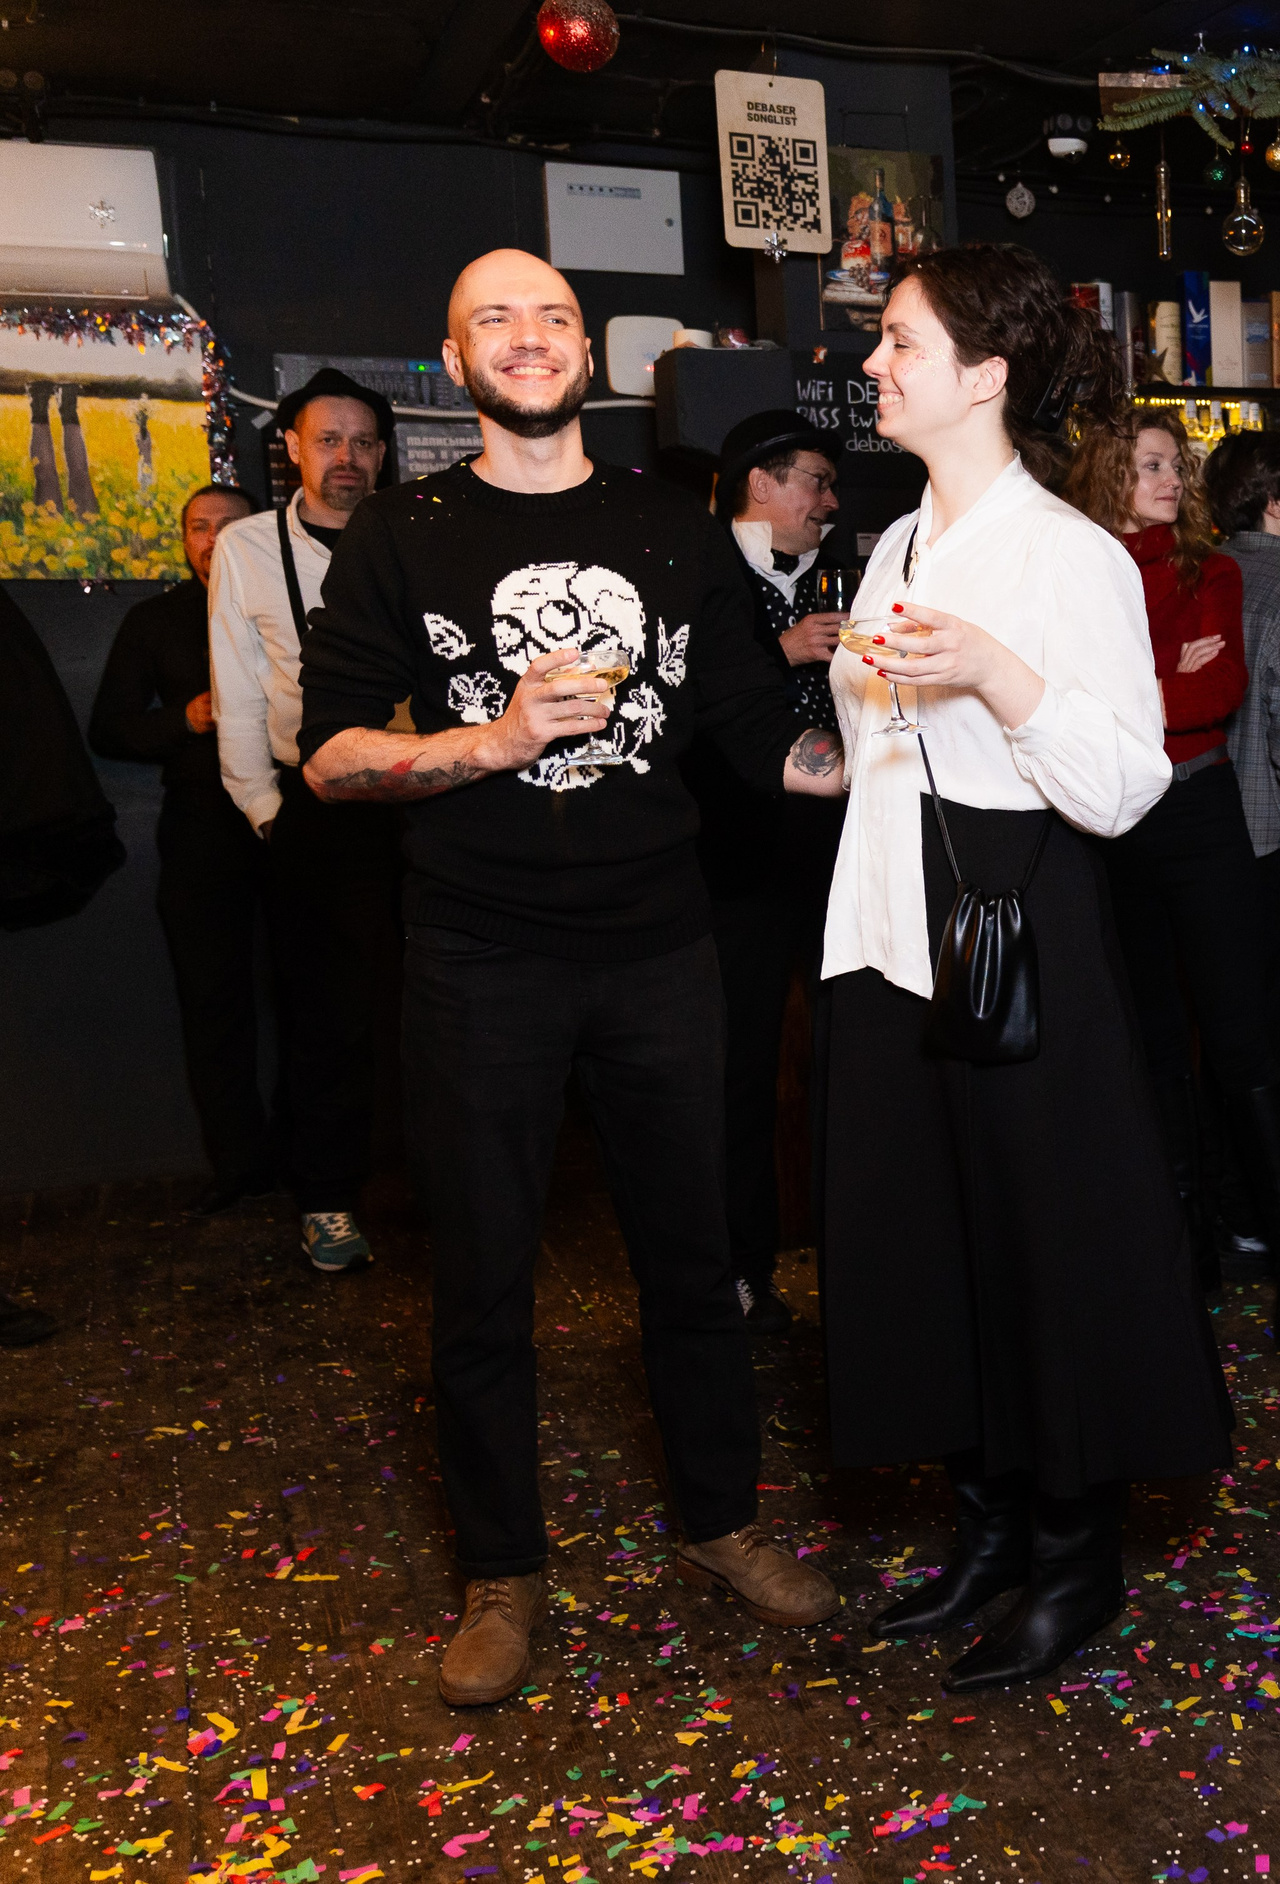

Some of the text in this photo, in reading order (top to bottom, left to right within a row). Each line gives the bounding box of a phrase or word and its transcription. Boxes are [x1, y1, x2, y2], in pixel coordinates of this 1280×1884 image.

[747, 101, 796, 115] DEBASER
[747, 112, 797, 126] SONGLIST
[845, 432, 909, 453] debas
